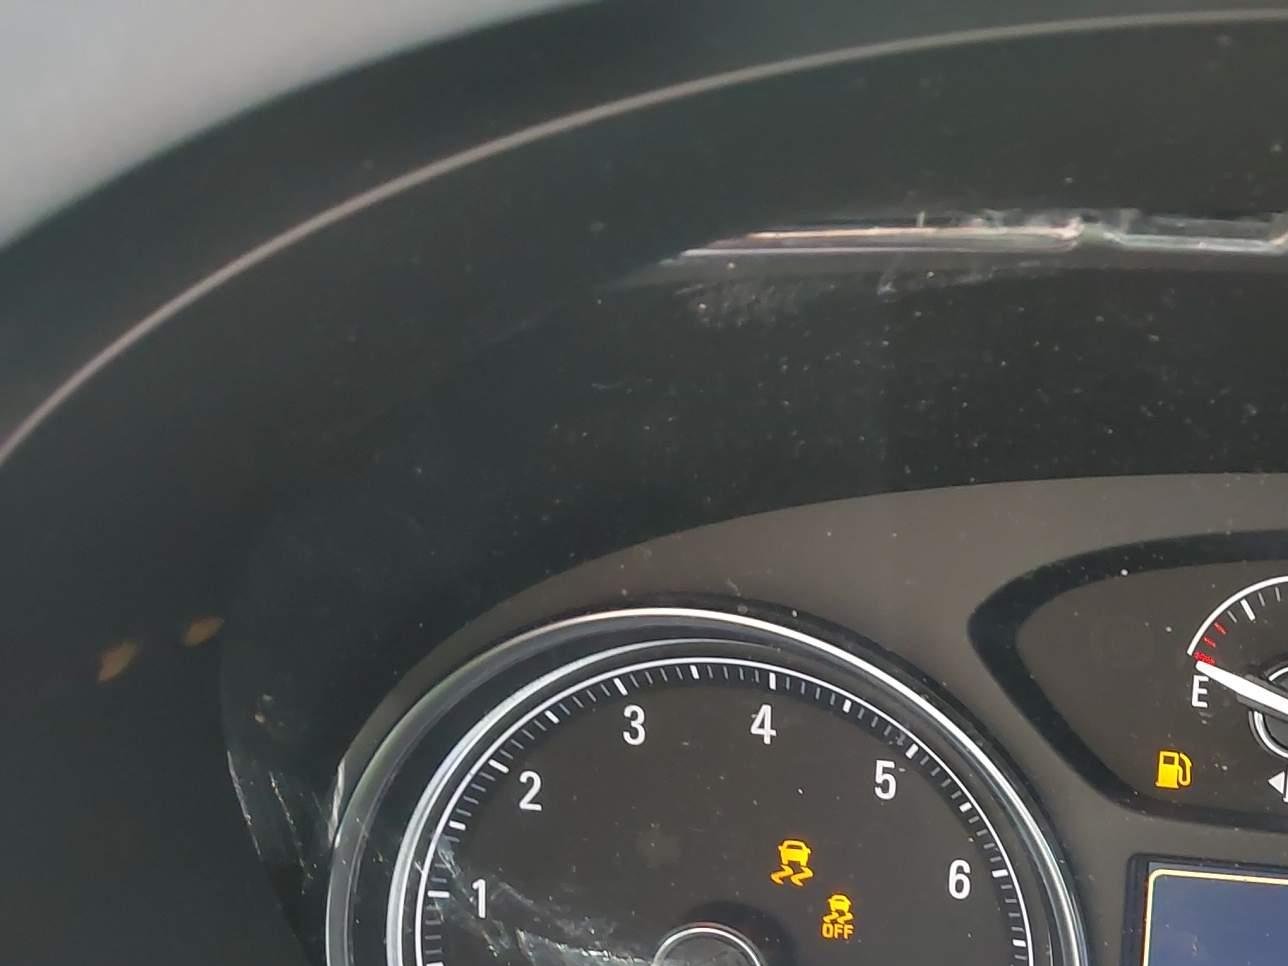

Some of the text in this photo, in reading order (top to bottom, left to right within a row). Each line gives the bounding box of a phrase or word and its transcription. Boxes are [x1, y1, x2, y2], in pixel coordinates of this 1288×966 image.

[1191, 676, 1209, 708] E
[623, 705, 646, 746] 3
[750, 704, 777, 745] 4
[519, 771, 543, 811] 2
[874, 759, 898, 801] 5
[472, 878, 487, 919] 1
[948, 859, 972, 900] 6
[821, 923, 854, 940] OFF
